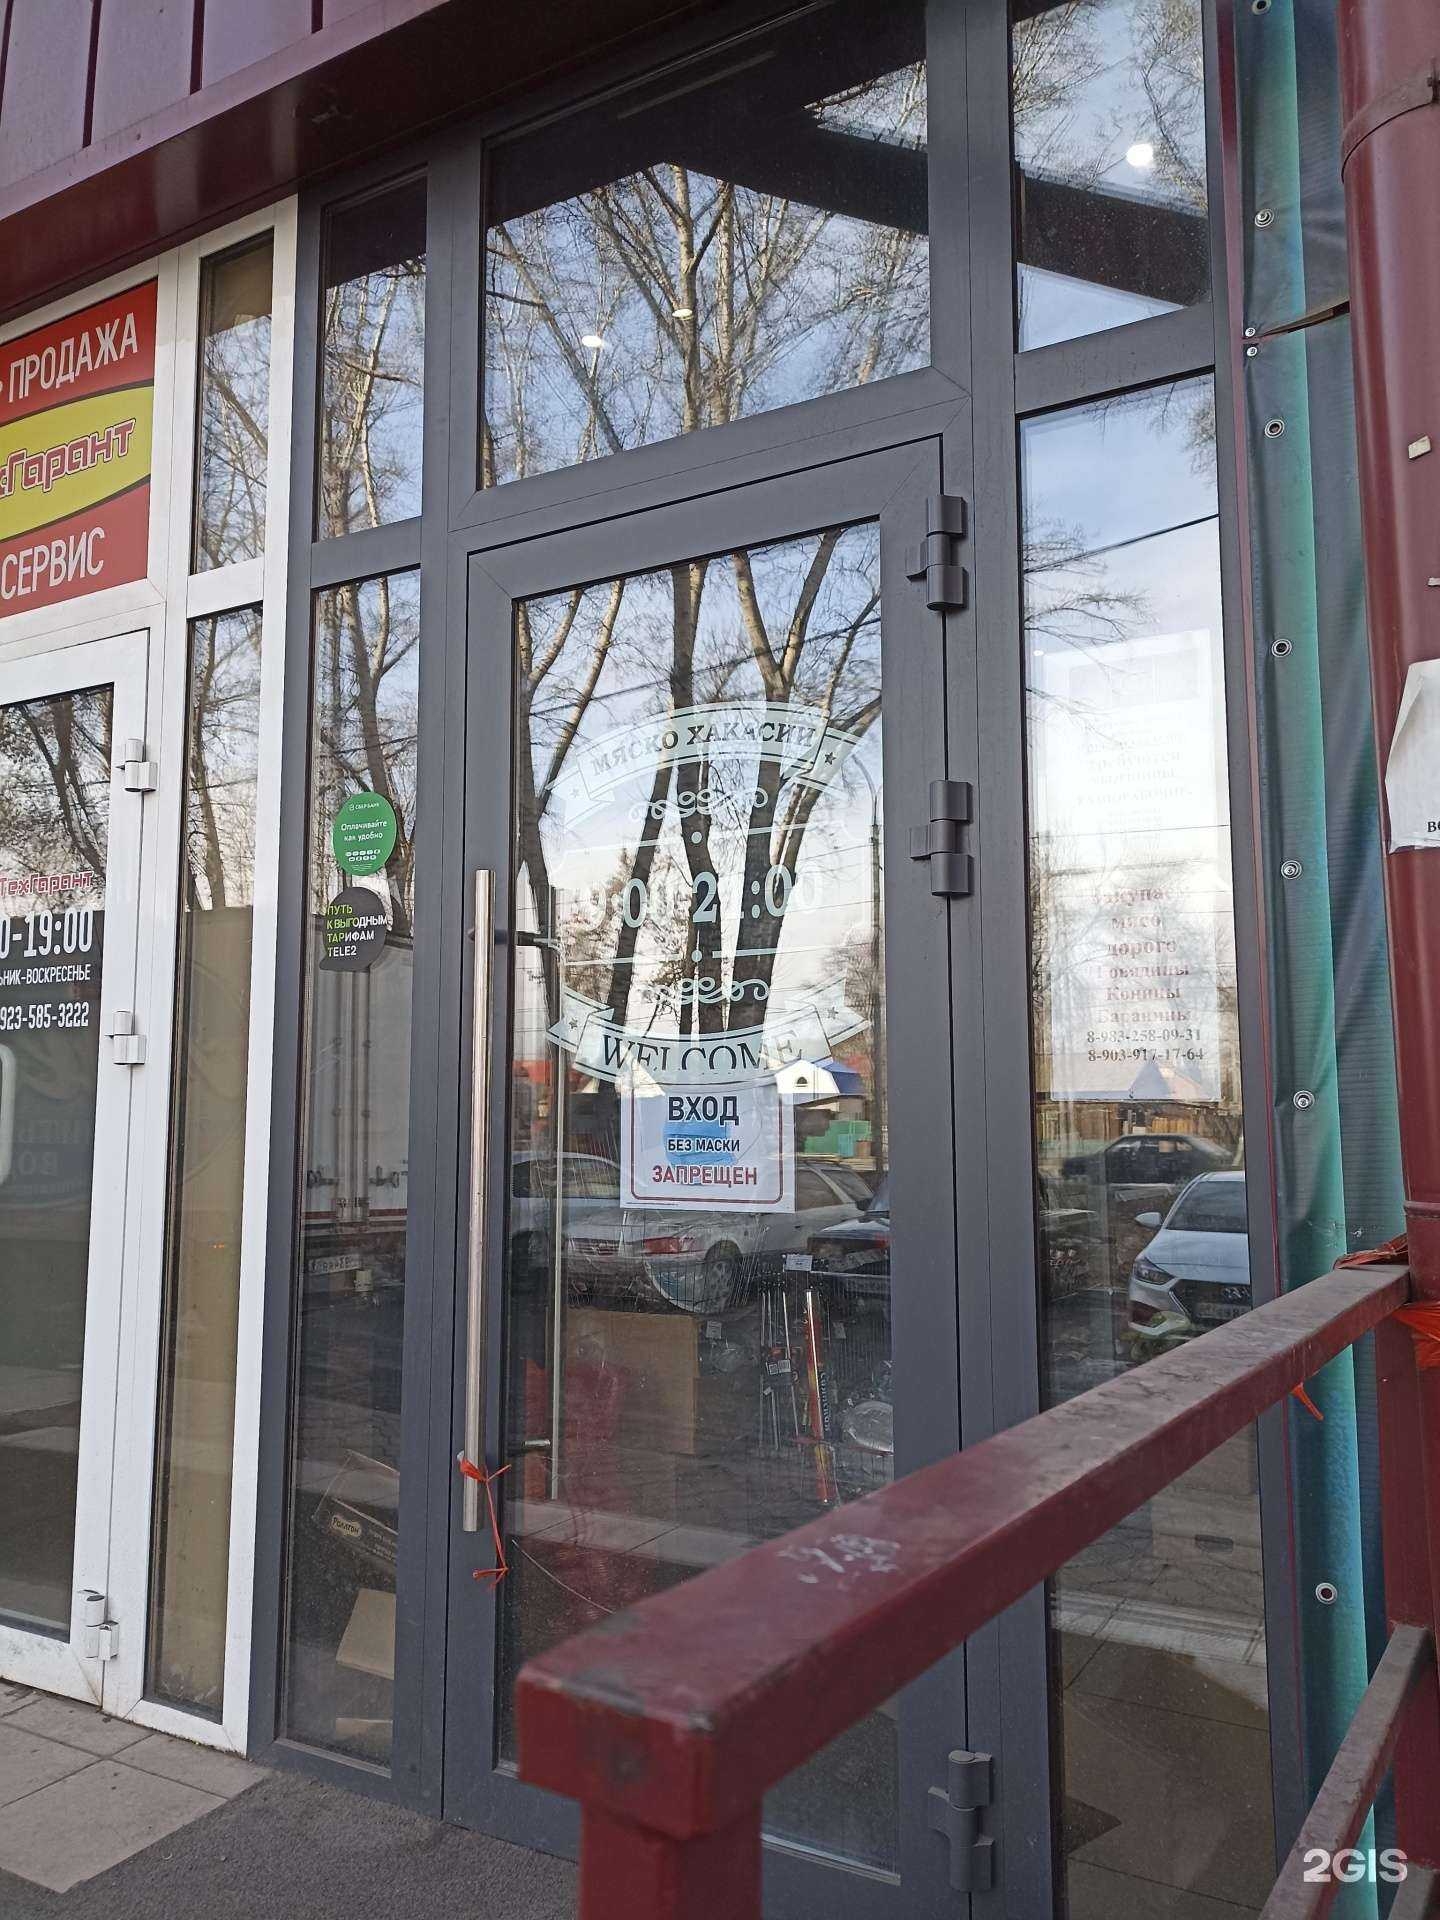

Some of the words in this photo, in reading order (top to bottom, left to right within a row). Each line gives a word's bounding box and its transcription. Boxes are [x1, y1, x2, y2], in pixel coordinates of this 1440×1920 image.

[9, 312, 138, 403] ПРОДАЖА
[1, 526, 105, 600] СЕРВИС
[687, 722, 816, 747] ХАКАСИИ
[341, 820, 388, 831] Оплачивайте
[358, 831, 383, 842] удобно
[328, 905, 353, 915] ПУТЬ
[327, 920, 333, 930] К
[334, 915, 387, 929] ВЫГОДНЫМ
[327, 930, 375, 943] ТАРИФАМ
[328, 945, 357, 957] TELE2
[1088, 1047, 1205, 1062] 8-903-917-17-64
[668, 1096, 740, 1126] ВХОД
[668, 1138, 692, 1152] БЕЗ
[696, 1138, 740, 1152] МАСКИ
[652, 1164, 757, 1188] ЗАПРЕЩЕН
